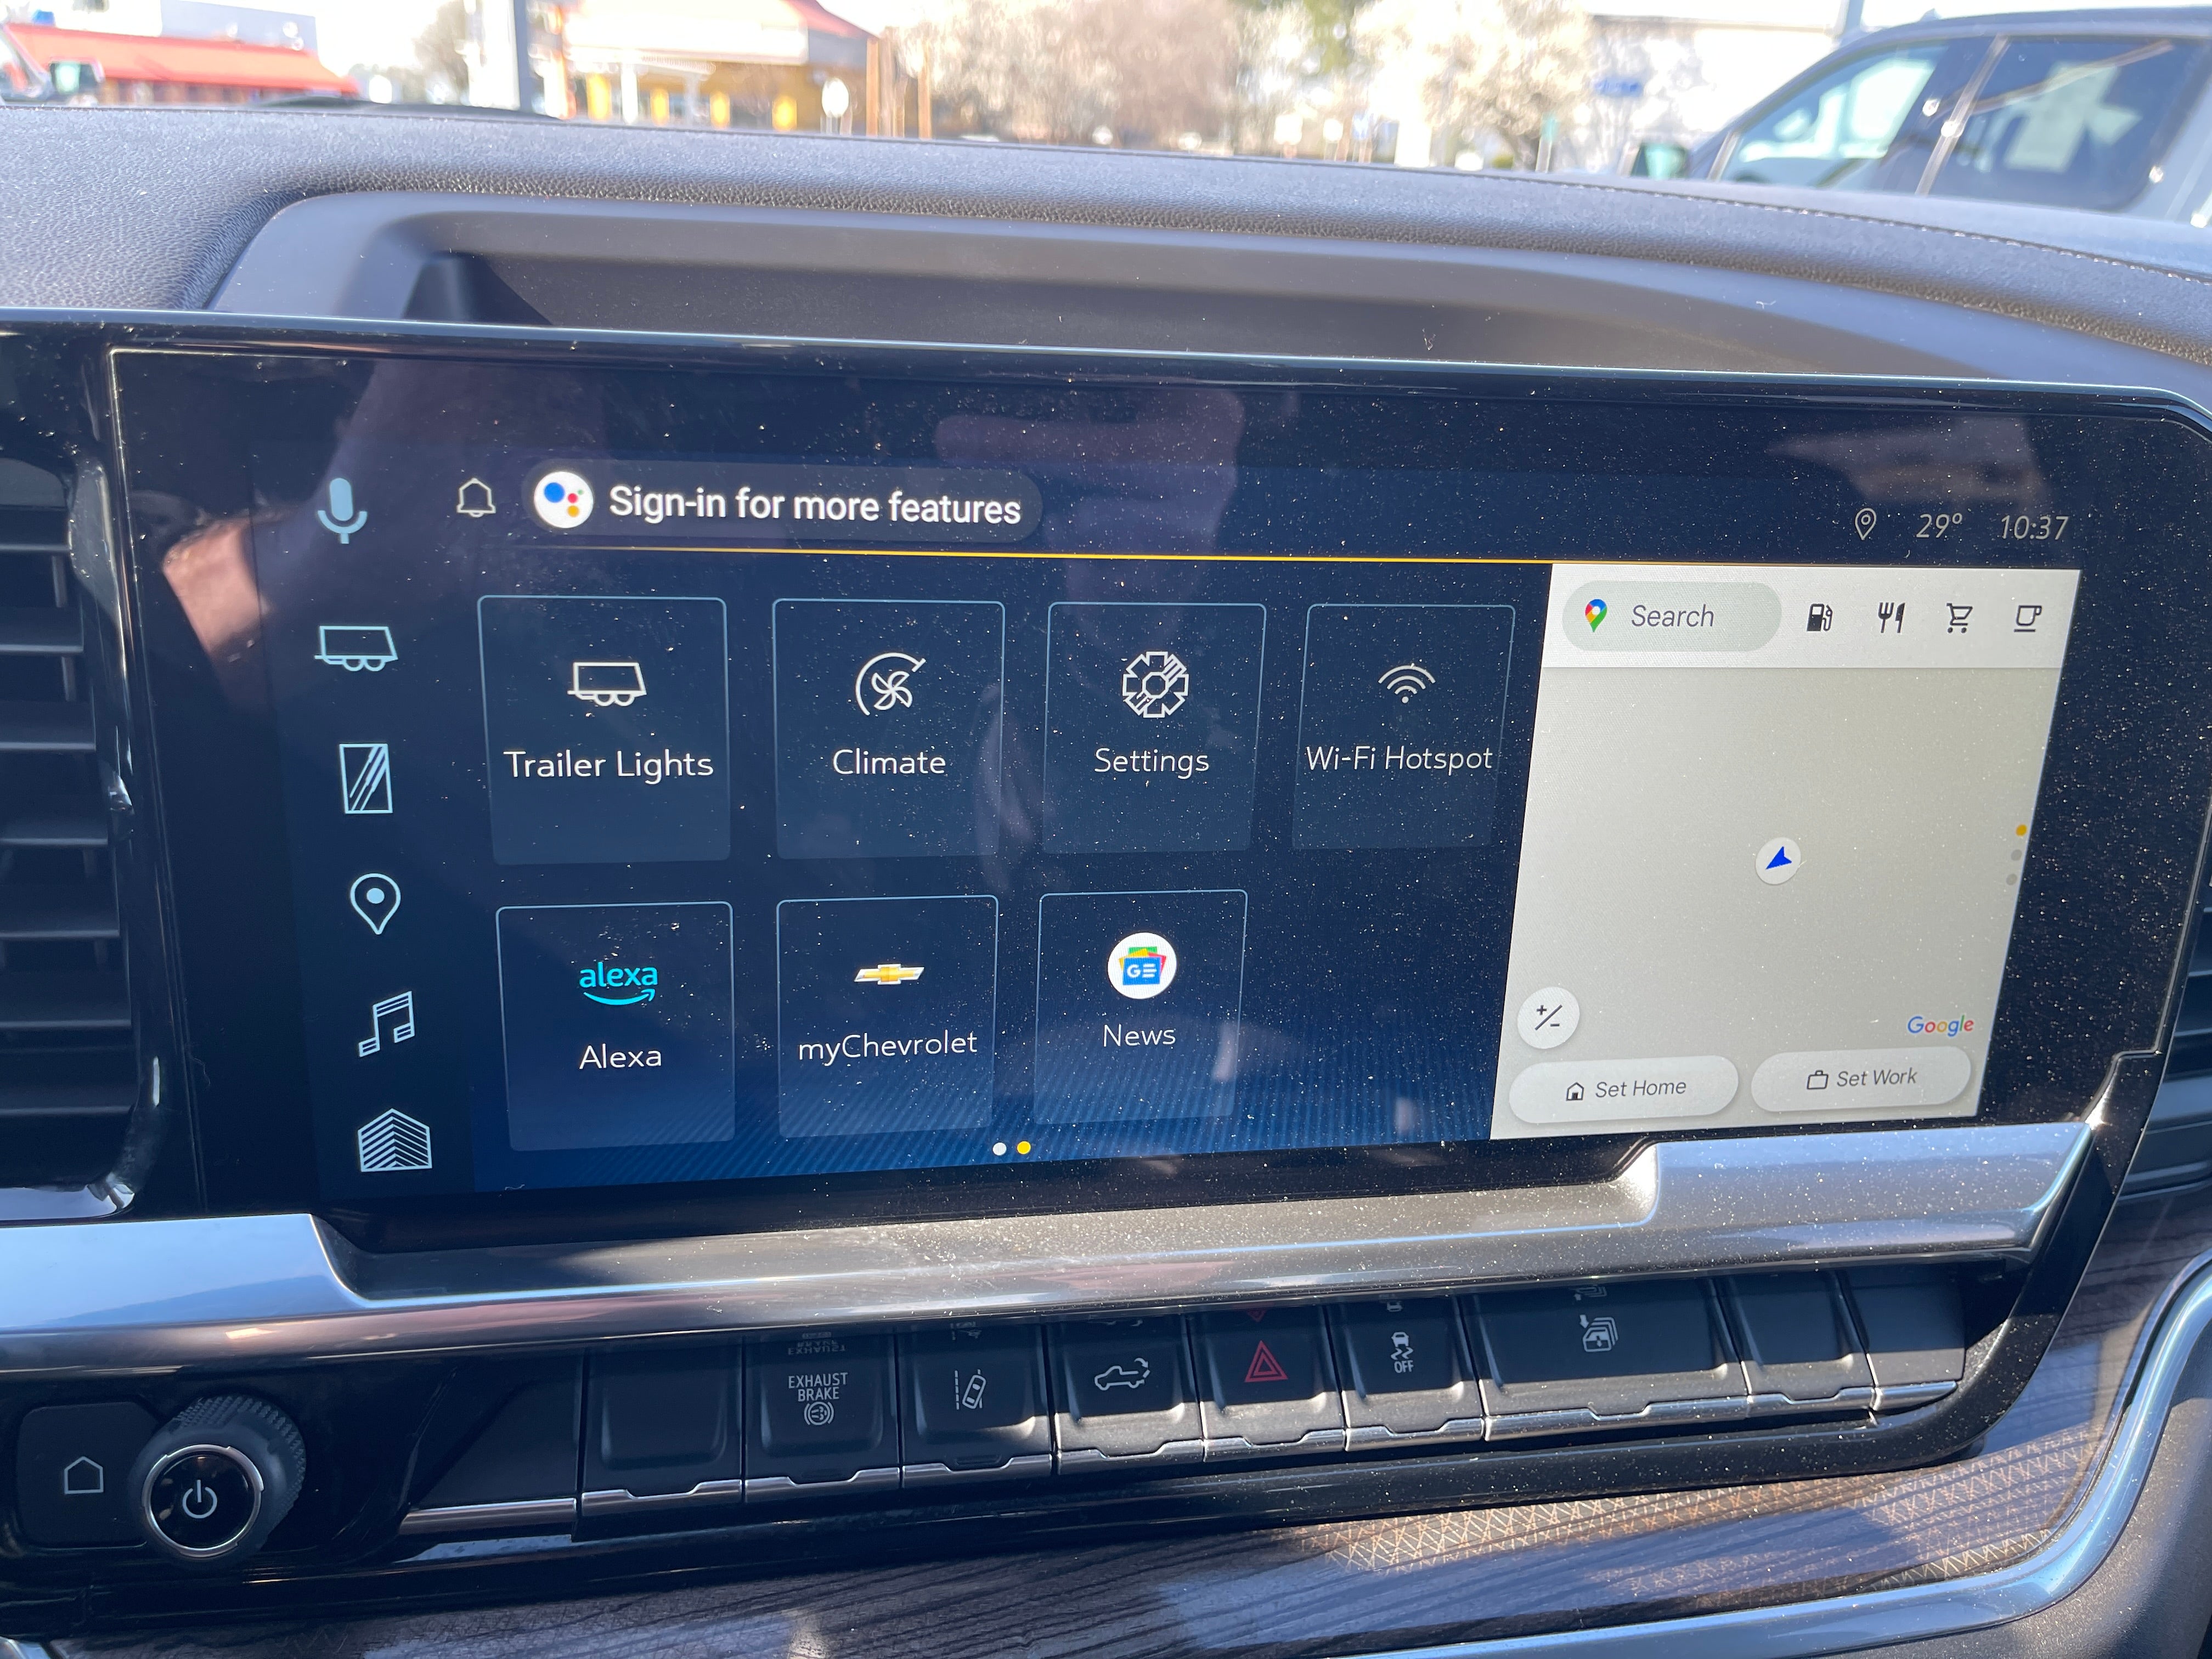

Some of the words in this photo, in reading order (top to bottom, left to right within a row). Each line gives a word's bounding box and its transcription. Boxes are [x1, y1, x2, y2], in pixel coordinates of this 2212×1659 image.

[610, 485, 726, 524] Sign-in
[735, 486, 785, 519] for
[794, 495, 879, 521] more
[888, 490, 1021, 524] features
[1916, 512, 1963, 538] 29°
[2001, 515, 2069, 540] 10:37
[1630, 603, 1715, 628] Search
[504, 750, 607, 777] Trailer
[616, 748, 714, 785] Lights
[832, 749, 946, 775] Climate
[1094, 748, 1210, 780] Settings
[1306, 746, 1375, 770] Wi-Fi
[1384, 747, 1493, 776] Hotspot
[579, 961, 658, 988] alexa
[1103, 1023, 1176, 1047] News
[1907, 1014, 1974, 1037] Google
[579, 1043, 663, 1070] Alexa
[798, 1029, 978, 1066] myChevrolet
[1594, 1081, 1628, 1098] Set
[1632, 1079, 1686, 1097] Home
[1836, 1070, 1868, 1087] Set
[1872, 1066, 1918, 1086] Work
[1394, 1360, 1414, 1374] OFF
[788, 1372, 848, 1389] EXHAUST
[797, 1386, 840, 1402] BRAKE
